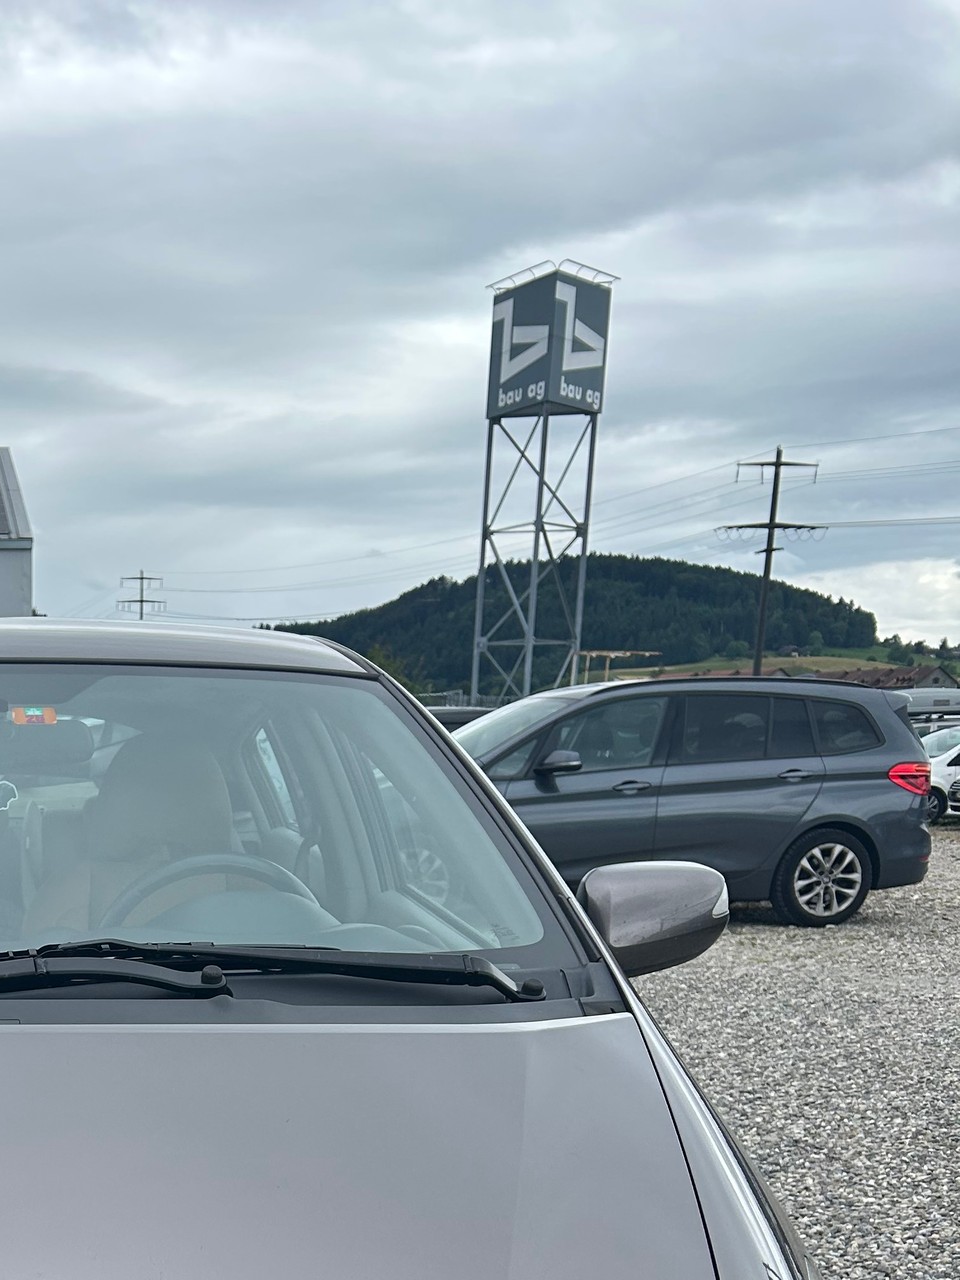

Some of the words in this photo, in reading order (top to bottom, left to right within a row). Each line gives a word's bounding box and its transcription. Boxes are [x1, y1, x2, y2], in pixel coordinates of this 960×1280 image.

[498, 387, 522, 407] bau
[527, 380, 546, 400] ag
[560, 376, 582, 400] bau
[586, 389, 601, 410] ag
